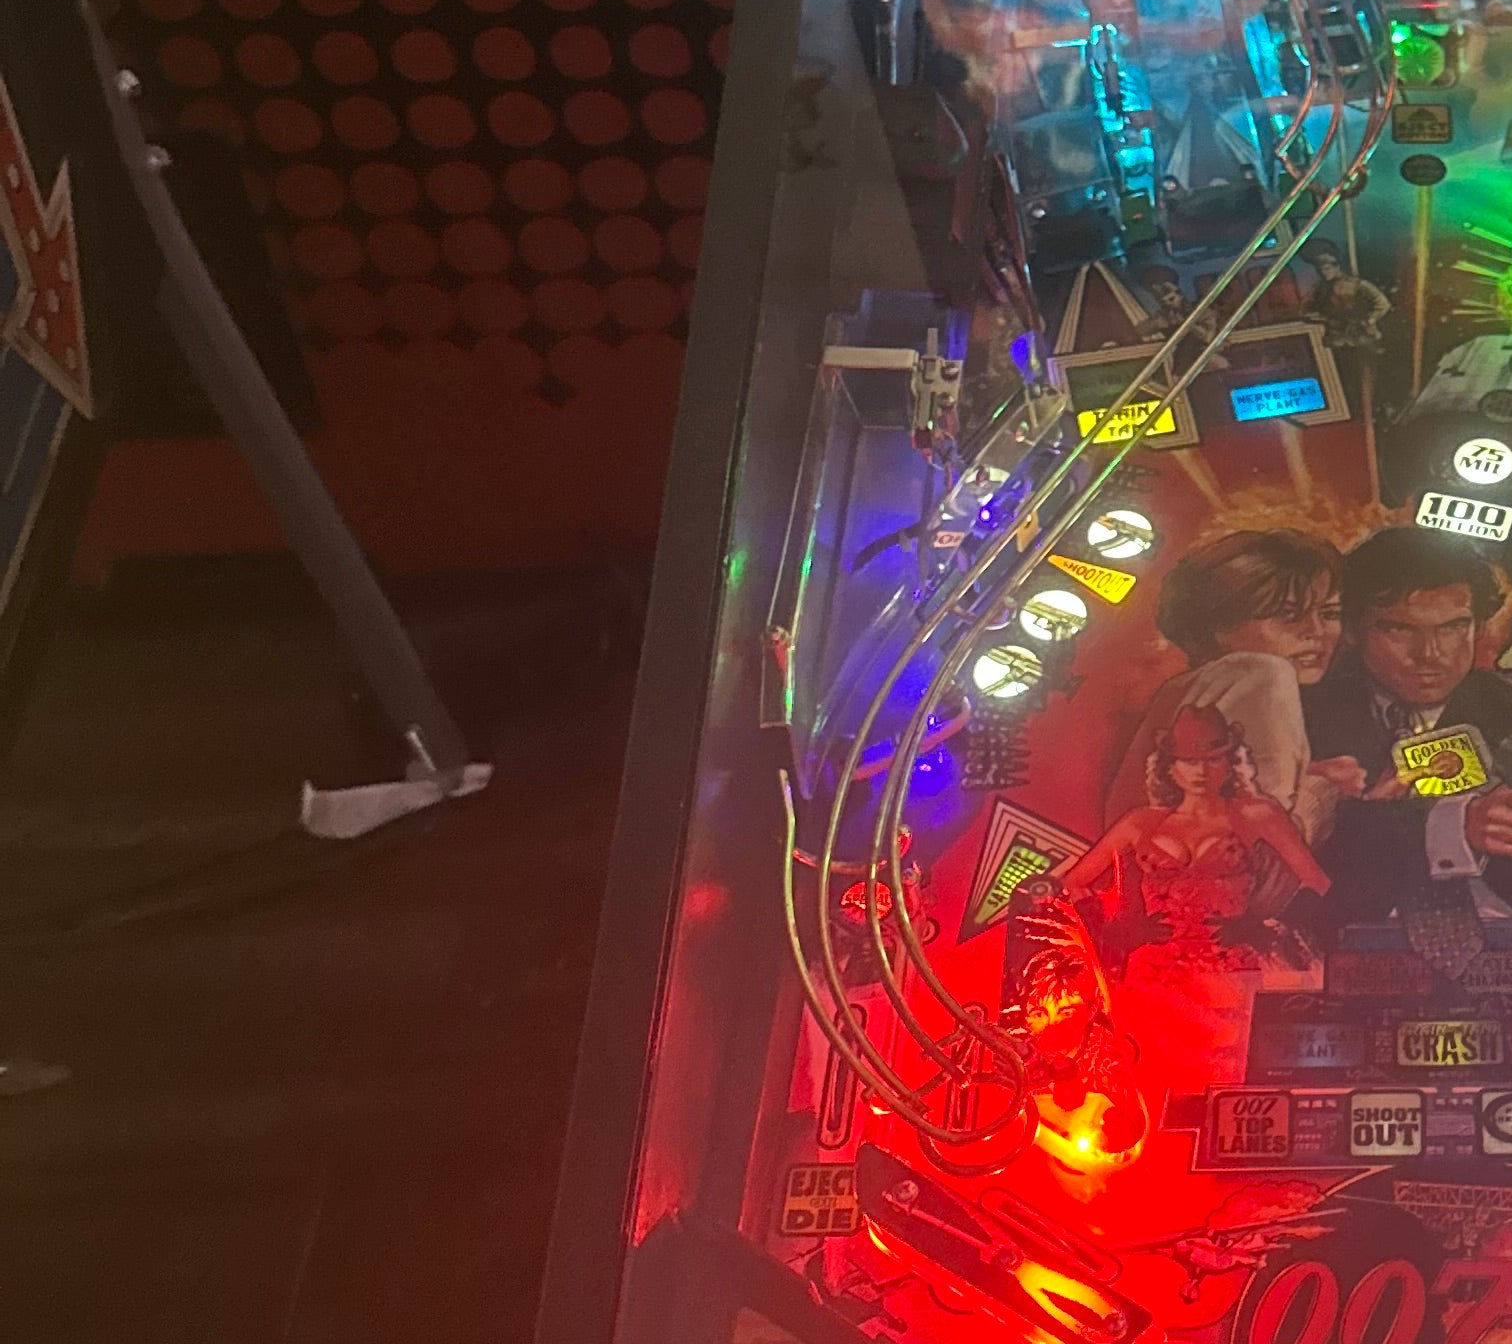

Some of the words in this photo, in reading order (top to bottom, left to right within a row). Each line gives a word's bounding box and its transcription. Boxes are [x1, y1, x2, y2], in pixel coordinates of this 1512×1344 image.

[1236, 390, 1284, 405] NERVE
[1257, 399, 1301, 413] PLANT
[1472, 444, 1507, 462] 75
[1458, 456, 1502, 474] MIL
[1428, 496, 1507, 527] 100
[1420, 515, 1504, 538] MILLION
[1403, 1032, 1498, 1064] CRASH
[1233, 1098, 1278, 1116] 007
[1353, 1107, 1420, 1122] SHOOT
[1234, 1116, 1274, 1134] TOP
[1353, 1124, 1419, 1146] OUT
[1218, 1135, 1287, 1154] LANES
[785, 1208, 855, 1230] DIE
